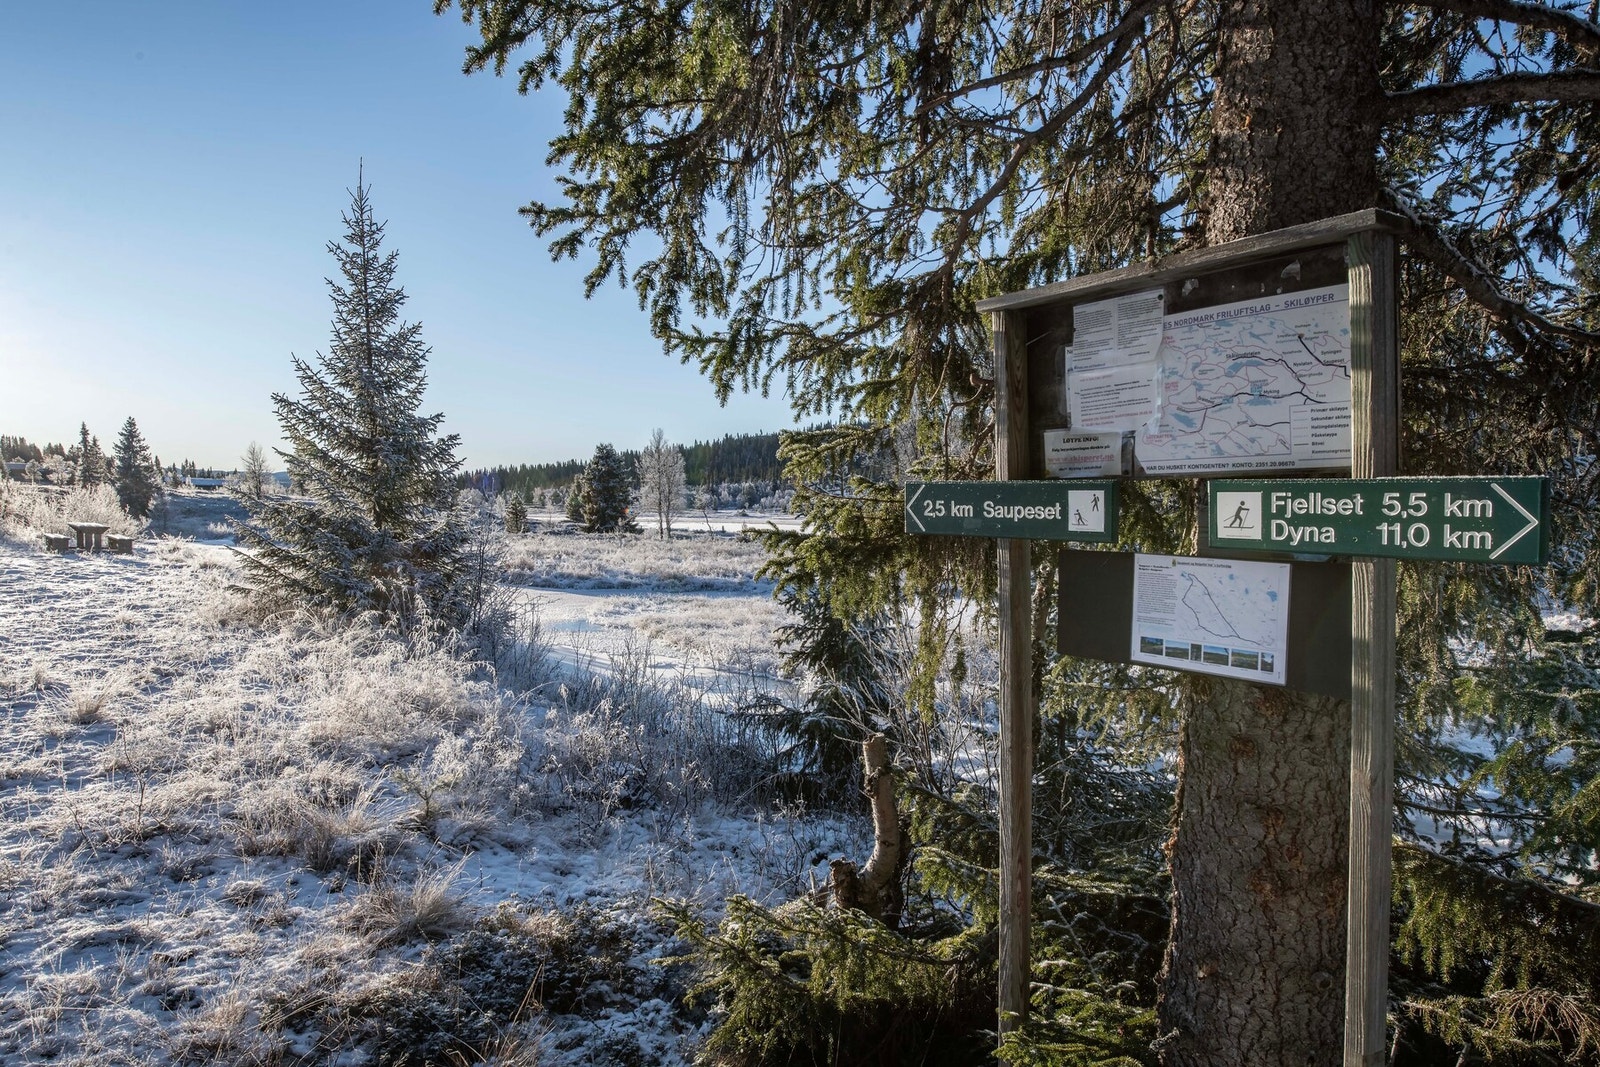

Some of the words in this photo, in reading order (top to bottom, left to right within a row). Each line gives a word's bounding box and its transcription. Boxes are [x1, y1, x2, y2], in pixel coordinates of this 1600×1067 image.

[1163, 321, 1173, 329] ES
[1173, 313, 1215, 328] NORDMARK
[1216, 303, 1271, 320] FRILUFTSLAG
[1284, 293, 1335, 309] SKILØYPER
[923, 500, 946, 518] 2,5
[950, 500, 974, 517] km
[983, 500, 1062, 522] Saupeset
[1270, 492, 1364, 518] Fjellset
[1381, 492, 1428, 518] 5,5
[1444, 492, 1493, 518] km
[1270, 519, 1336, 546] Dyna
[1376, 522, 1430, 549] 11,0
[1443, 524, 1492, 550] km
